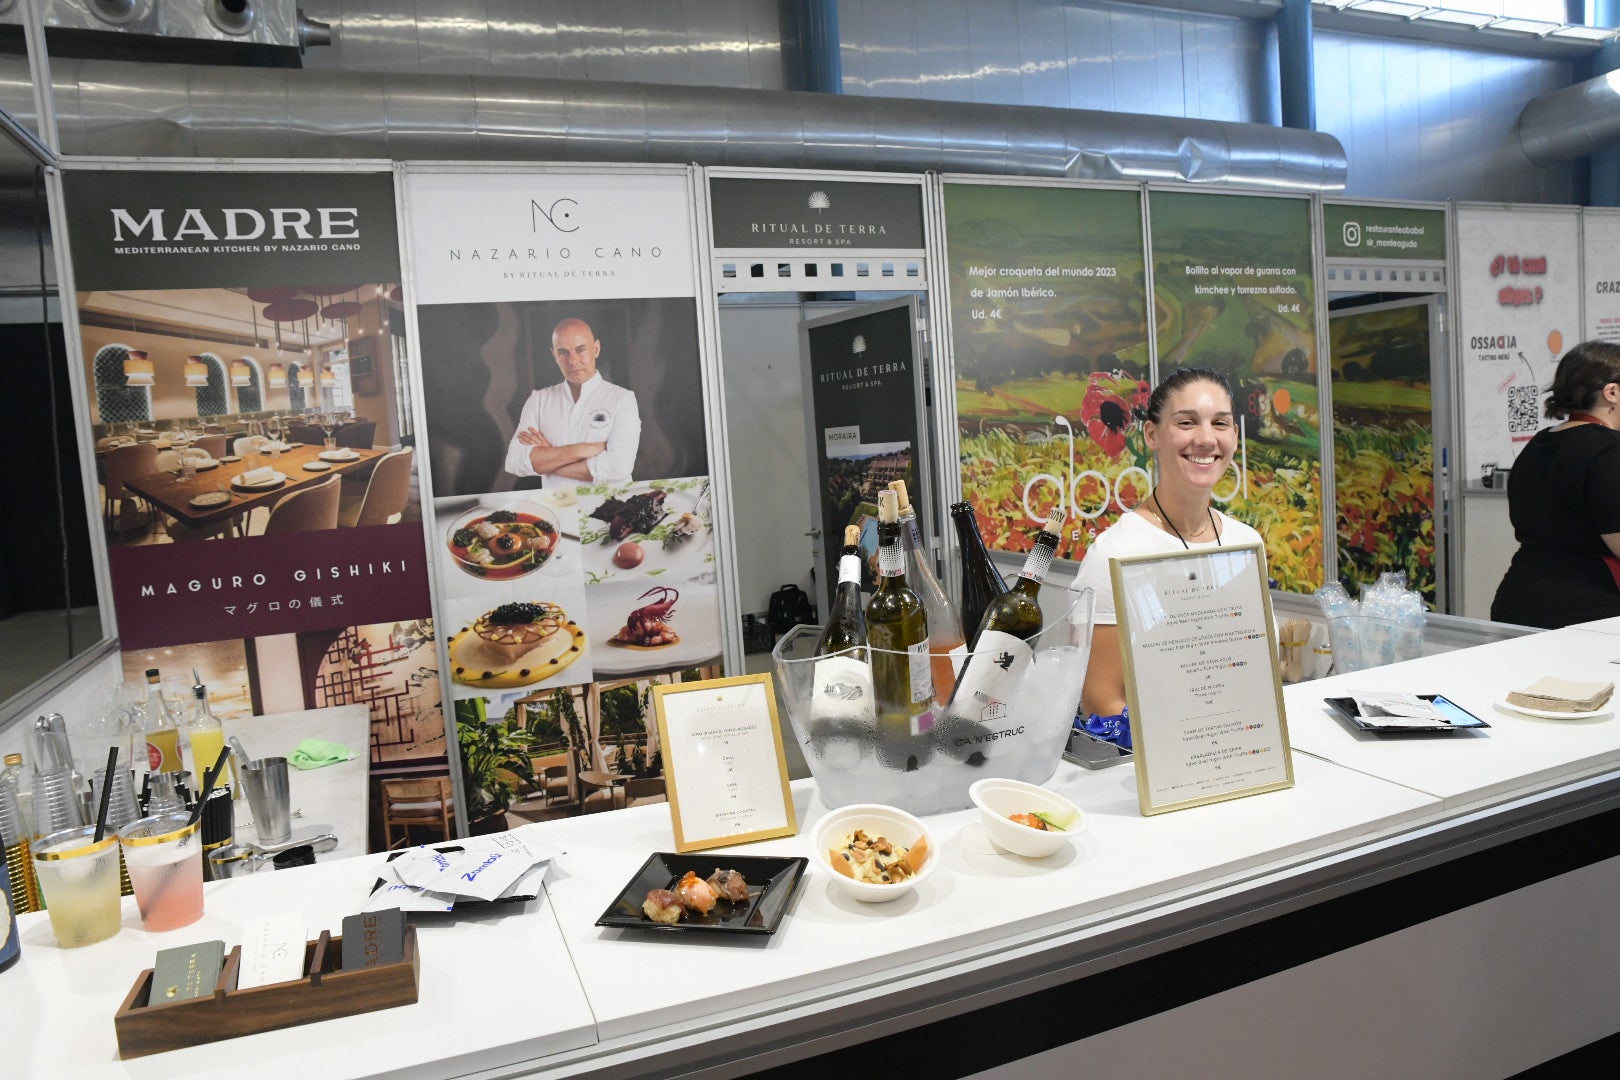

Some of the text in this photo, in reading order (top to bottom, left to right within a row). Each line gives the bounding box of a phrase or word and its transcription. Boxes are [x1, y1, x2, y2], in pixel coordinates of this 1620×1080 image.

[110, 207, 360, 242] MADRE
[751, 222, 887, 235] RITUAL DE TERRA
[114, 245, 210, 255] MEDITERRANEAN
[213, 245, 261, 253] KITCHEN
[282, 244, 328, 252] NAZARIO
[332, 243, 361, 251] CANO
[449, 246, 662, 261] NAZARIO CANO
[519, 271, 560, 279] RITUAL
[581, 270, 616, 278] TERRA
[968, 266, 1117, 279] Mejor croqueta del mundo 2023
[1185, 265, 1296, 277] Bollito al vapor de guarra con
[970, 287, 1057, 298] de Jamón Ibérico.
[1194, 285, 1230, 295] kimchee
[1231, 287, 1236, 296] y
[1237, 285, 1267, 295] torrezno
[972, 309, 1002, 320] Ud. 4€
[1278, 304, 1300, 313] Ud. 4€
[820, 361, 906, 383] RITUAL DE TERRA
[141, 560, 406, 597] MAGURO GISHIKI
[223, 594, 344, 616] マグロの儀式
